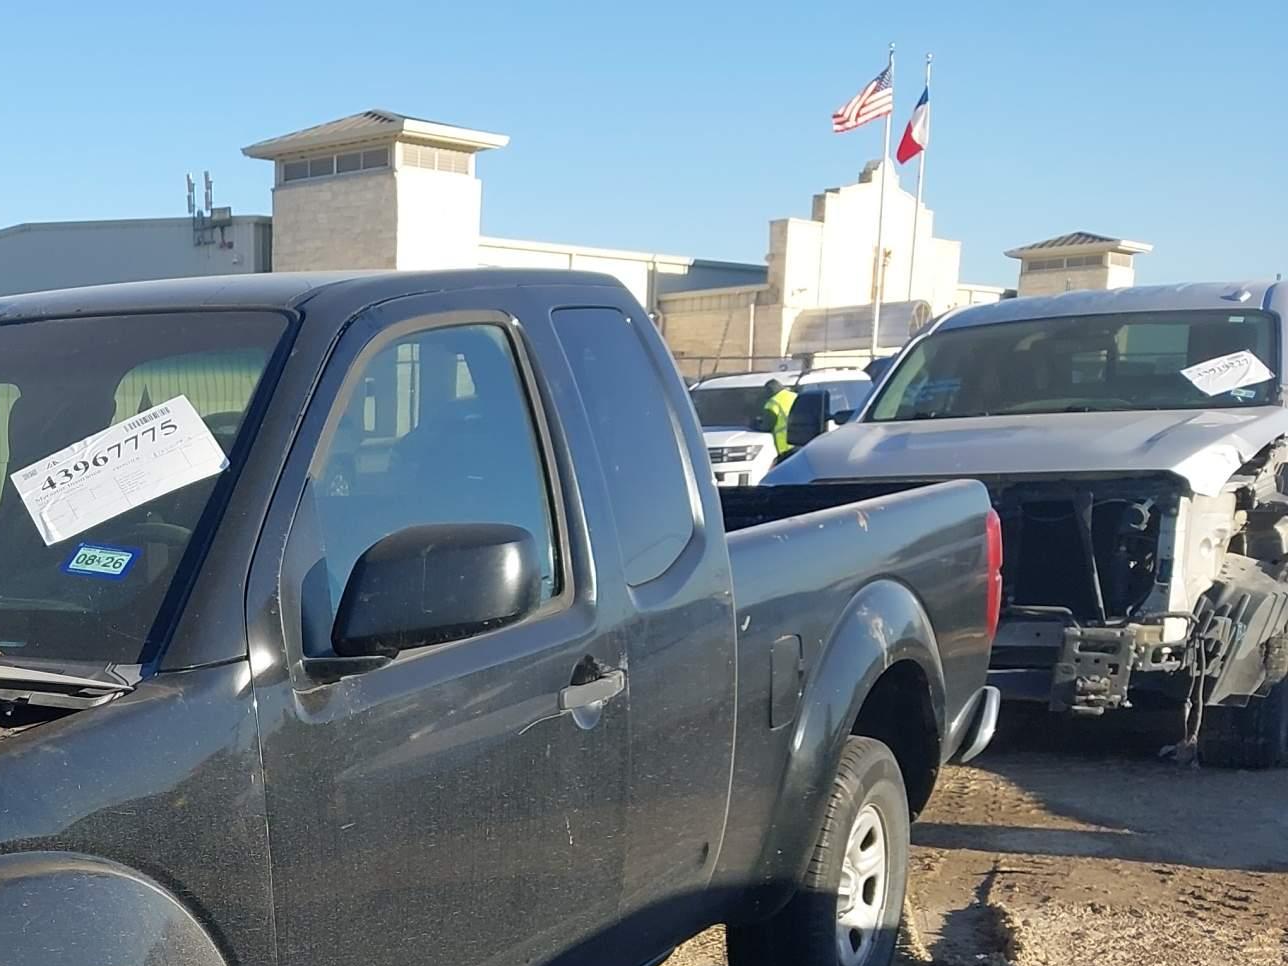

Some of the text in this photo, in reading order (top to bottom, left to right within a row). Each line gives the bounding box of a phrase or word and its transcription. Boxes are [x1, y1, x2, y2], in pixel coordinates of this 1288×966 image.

[41, 418, 178, 491] 43967775
[75, 553, 98, 566] 08
[100, 556, 125, 569] 26
